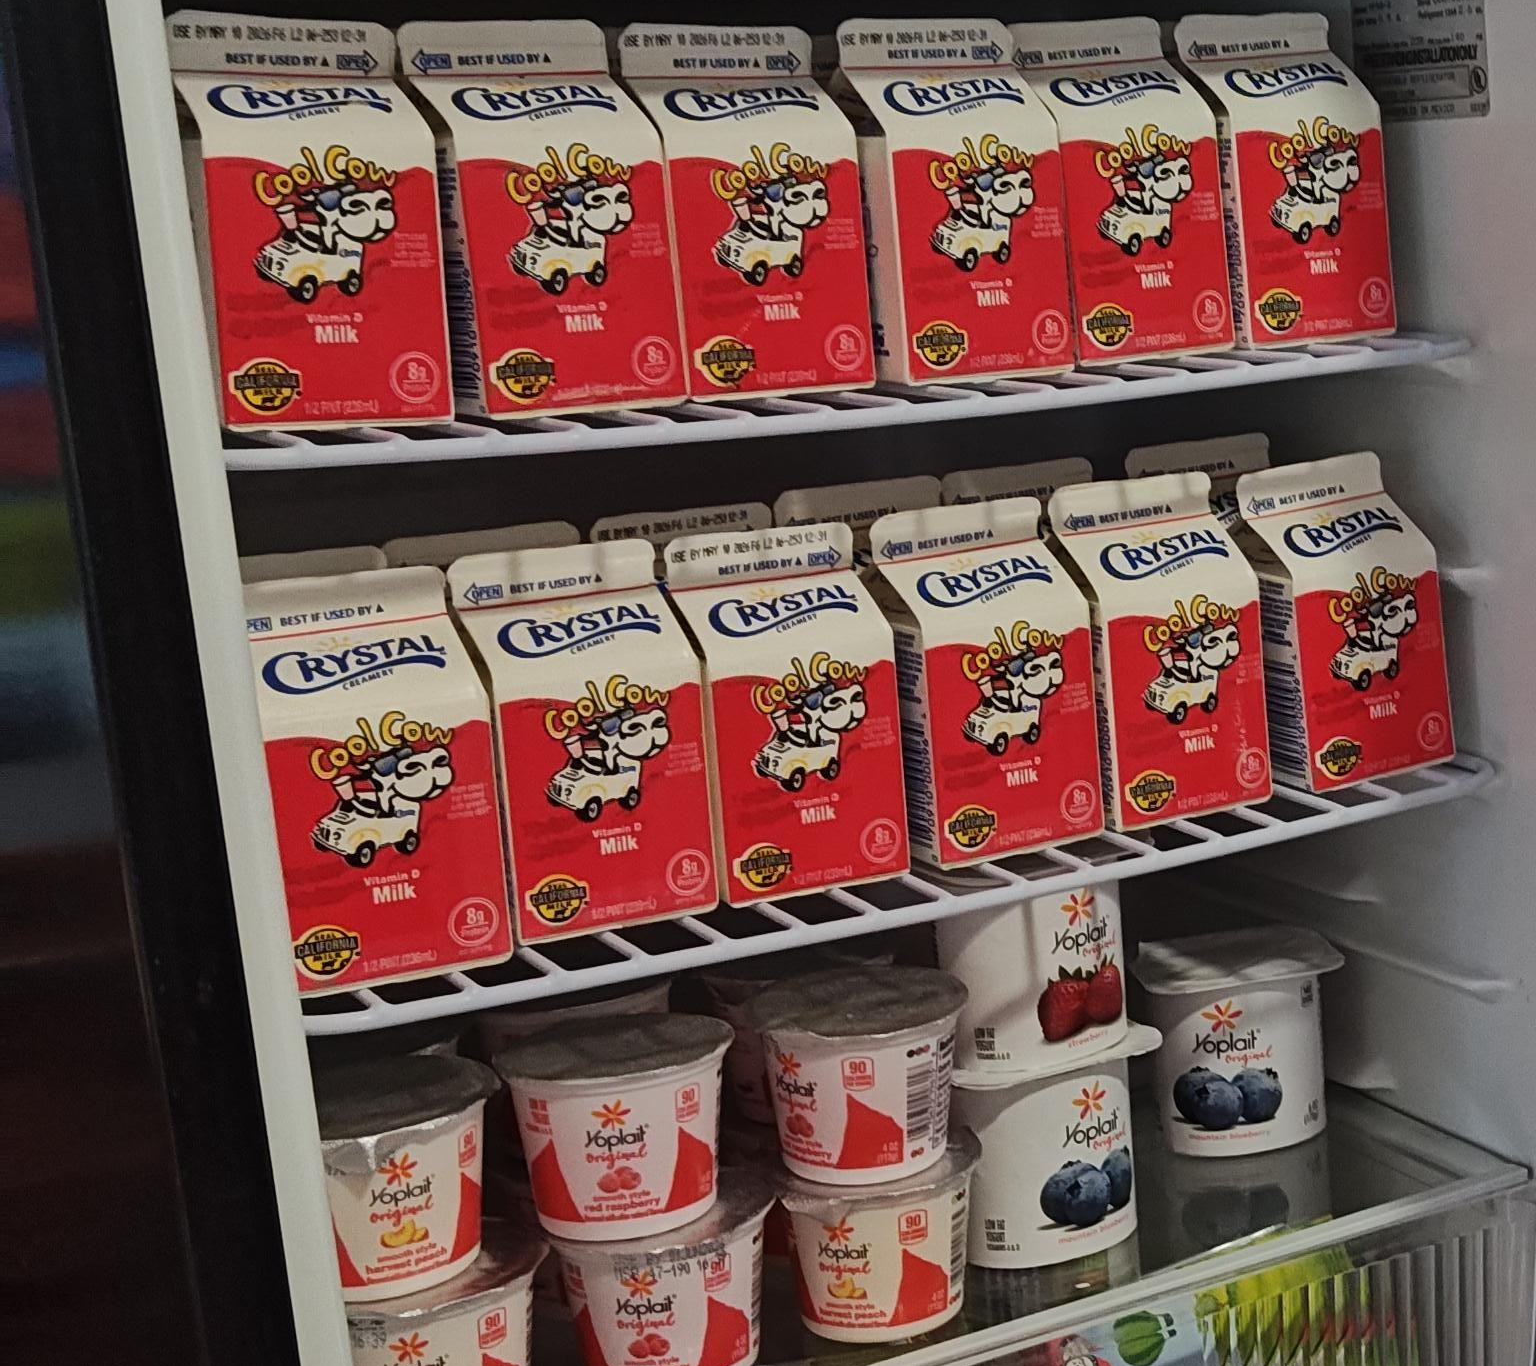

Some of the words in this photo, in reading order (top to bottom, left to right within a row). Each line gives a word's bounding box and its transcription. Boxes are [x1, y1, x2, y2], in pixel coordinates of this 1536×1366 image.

[458, 55, 483, 66] BEST
[486, 54, 494, 65] IF
[497, 53, 525, 65] USED
[527, 53, 541, 64] BY
[883, 77, 1025, 116] CRYSTAL
[1050, 71, 1181, 107] CRYSTAL
[1224, 63, 1348, 98] CRYSTAL
[207, 84, 392, 118] CRYSTAL
[451, 85, 617, 120] CRYSTAL
[663, 86, 819, 121] CRYSTAL
[1094, 127, 1141, 179] Cool
[1141, 124, 1192, 156] Cow
[1268, 119, 1313, 169] Cool
[1313, 116, 1360, 148] Cow
[254, 146, 324, 206] Cool
[324, 145, 396, 188] Cow
[506, 146, 567, 204] Cool
[567, 143, 632, 181] Cow
[712, 145, 770, 201] Cool
[770, 142, 829, 179] Cow
[929, 137, 980, 190] Cool
[980, 134, 1035, 168] Cow
[764, 304, 801, 322] Milk
[976, 289, 1010, 308] Milk
[315, 325, 359, 344] Milk
[565, 314, 604, 333] Milk
[1283, 507, 1404, 558] CRYSTAL
[1100, 529, 1229, 581] CRYSTAL
[510, 583, 534, 595] BEST
[538, 581, 546, 592] IF
[549, 577, 577, 589] USED
[579, 575, 592, 585] BY
[916, 555, 1053, 608] CRYSTAL
[1327, 572, 1372, 624] Cool
[1371, 566, 1417, 592] Cow
[280, 615, 307, 627] BEST
[311, 613, 320, 623] IF
[324, 608, 355, 622] USED
[357, 605, 373, 617] BY
[708, 584, 859, 637] CRYSTAL
[1143, 600, 1190, 651] Cool
[1191, 594, 1240, 623] Cow
[497, 603, 662, 659] CRYSTAL
[262, 635, 446, 695] CRYSTAL
[961, 626, 1011, 681] Cool
[1011, 620, 1064, 650] Cow
[342, 668, 394, 691] CREAMERY
[1369, 702, 1398, 720] Milk
[1184, 735, 1215, 754] Milk
[1006, 768, 1039, 788] Milk
[801, 804, 836, 825] Milk
[600, 835, 639, 856] Milk
[364, 873, 408, 886] Vitamin
[372, 883, 417, 904] Milk
[1051, 917, 1108, 956] Yoplait
[1192, 1032, 1258, 1059] Yoplait
[848, 1061, 866, 1075] 90
[679, 1088, 695, 1104] 90
[584, 1125, 646, 1152] Yoplait
[1062, 1111, 1120, 1150] Yoplait
[369, 1177, 434, 1209] Yoplait
[583, 1201, 602, 1214] red
[605, 1196, 661, 1216] raspberry
[817, 1240, 869, 1262] Yoplait
[615, 1295, 674, 1320] Yoplait
